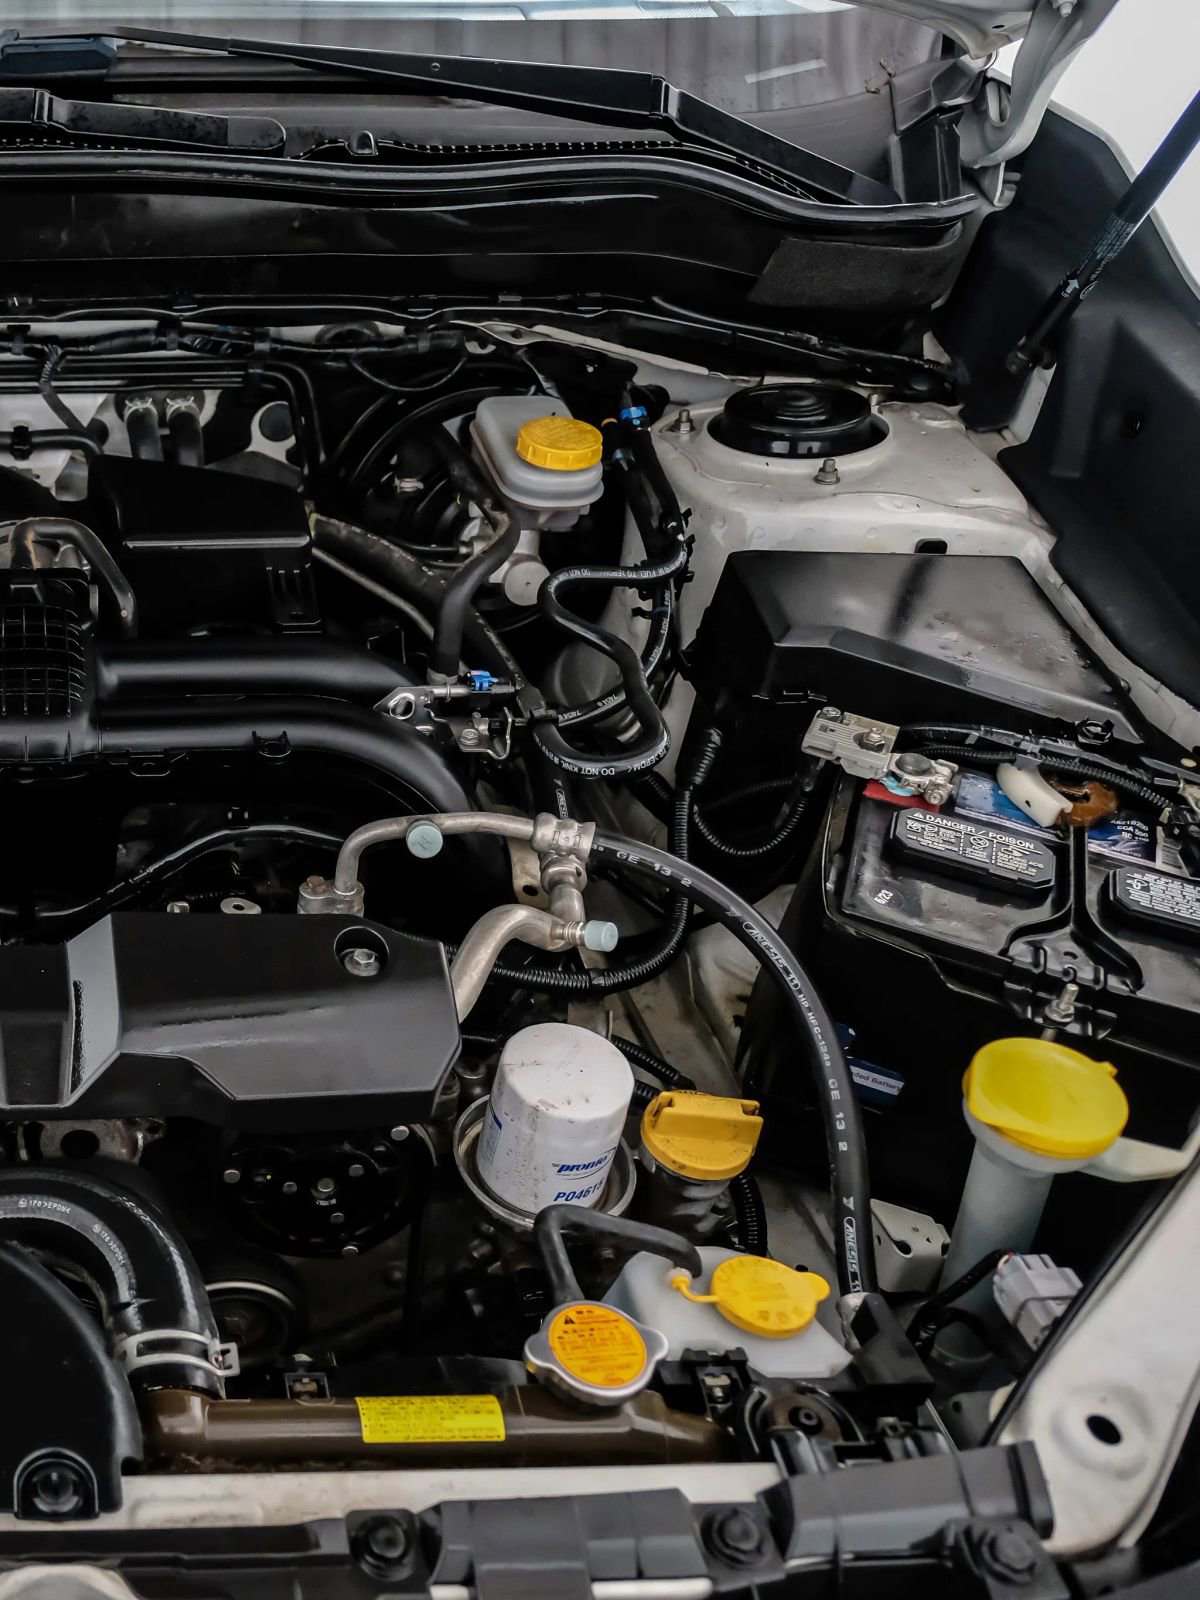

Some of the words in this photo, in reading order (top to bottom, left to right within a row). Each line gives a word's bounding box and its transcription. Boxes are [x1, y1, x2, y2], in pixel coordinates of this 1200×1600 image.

[581, 767, 599, 776] NOT
[601, 767, 615, 776] DO
[926, 814, 976, 834] DANGER
[988, 832, 1035, 850] POISON
[653, 863, 672, 877] 13
[680, 877, 692, 887] 2
[798, 993, 809, 1009] HP
[835, 1111, 846, 1130] 13
[838, 1141, 848, 1151] 2
